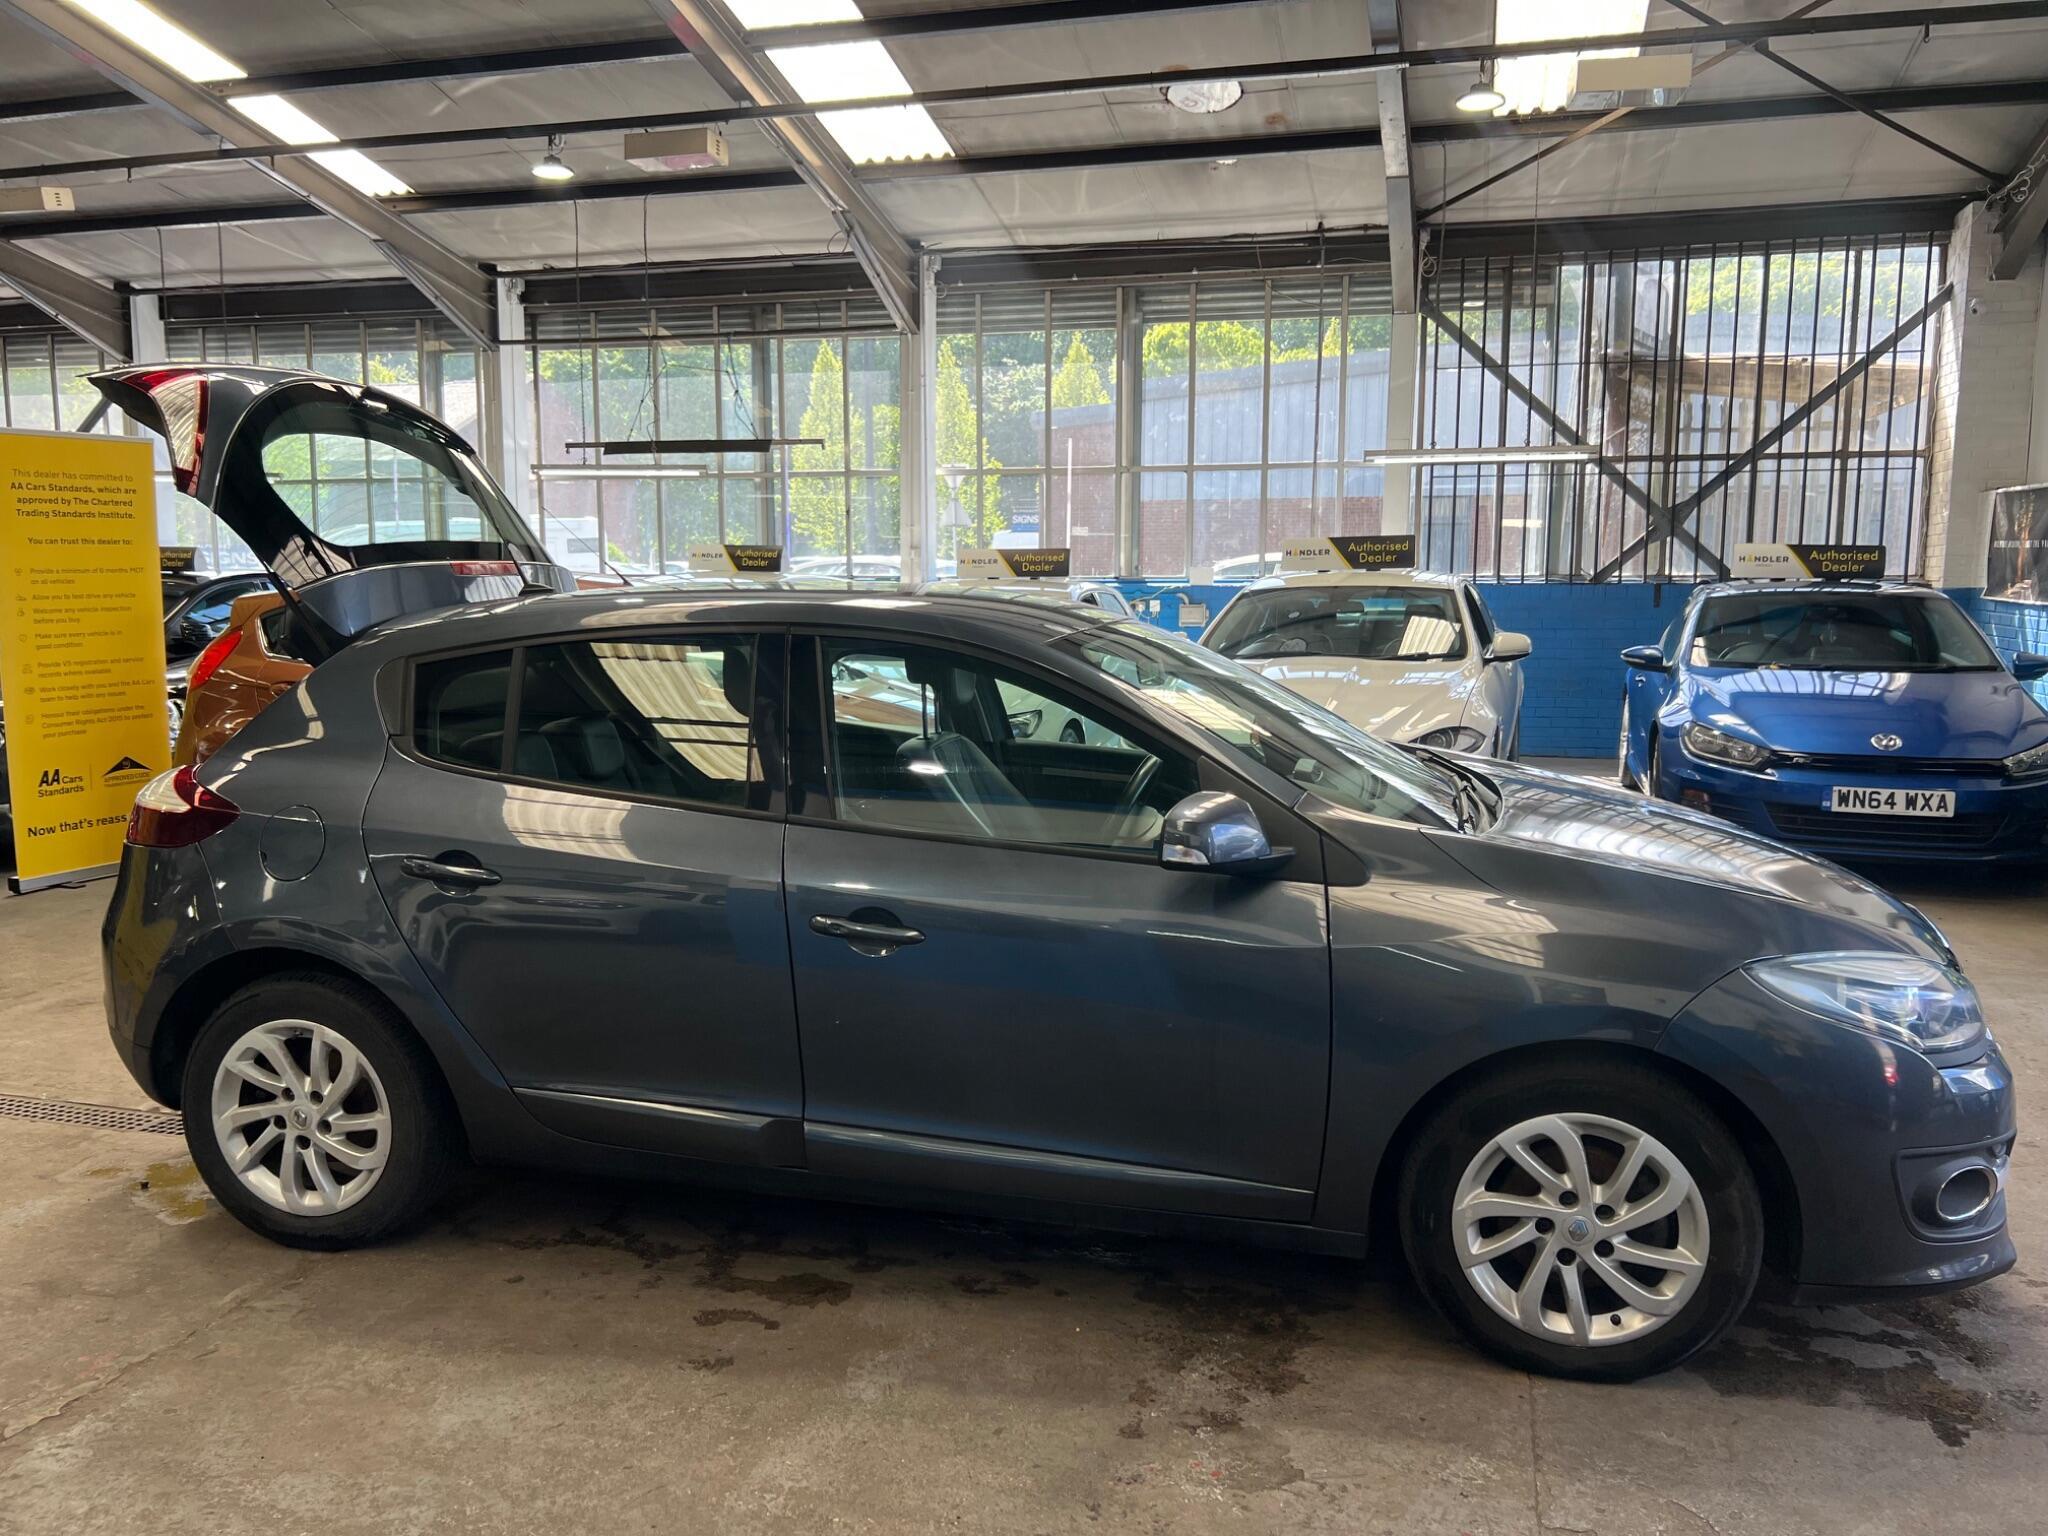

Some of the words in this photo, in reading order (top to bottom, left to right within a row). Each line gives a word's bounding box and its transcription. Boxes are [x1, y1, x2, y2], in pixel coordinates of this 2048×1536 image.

[12, 469, 31, 477] This
[33, 470, 59, 479] dealer
[62, 471, 77, 479] has
[79, 472, 123, 481] committed
[125, 474, 133, 482] to
[10, 482, 24, 490] AA
[26, 483, 46, 491] Cars
[48, 483, 95, 493] Standards,
[97, 485, 122, 494] which
[124, 487, 137, 495] are
[16, 496, 59, 506] approved
[61, 497, 71, 506] by
[91, 498, 133, 507] Chartered
[16, 509, 49, 518] Trading
[52, 509, 96, 518] Standards
[98, 511, 136, 519] Institute.
[1012, 514, 1039, 524] SIGNS
[27, 537, 42, 545] You
[1347, 540, 1409, 552] Authorised
[160, 551, 192, 559] uthorised
[735, 548, 778, 558] Authorised
[1013, 553, 1065, 562] Authorised
[1359, 552, 1397, 563] Dealer
[1809, 549, 1879, 561] Authorised
[162, 559, 185, 567] Dealer
[741, 558, 769, 567] Dealer
[1022, 562, 1054, 572] Dealer
[1822, 561, 1864, 572] Dealer
[38, 768, 61, 788] AA
[61, 774, 83, 784] Cars
[38, 785, 84, 798] Standards
[1837, 789, 1897, 810] WN64
[1904, 792, 1949, 813] WXA
[27, 826, 57, 838] Now
[59, 818, 94, 833] that's
[96, 813, 128, 827] reass
